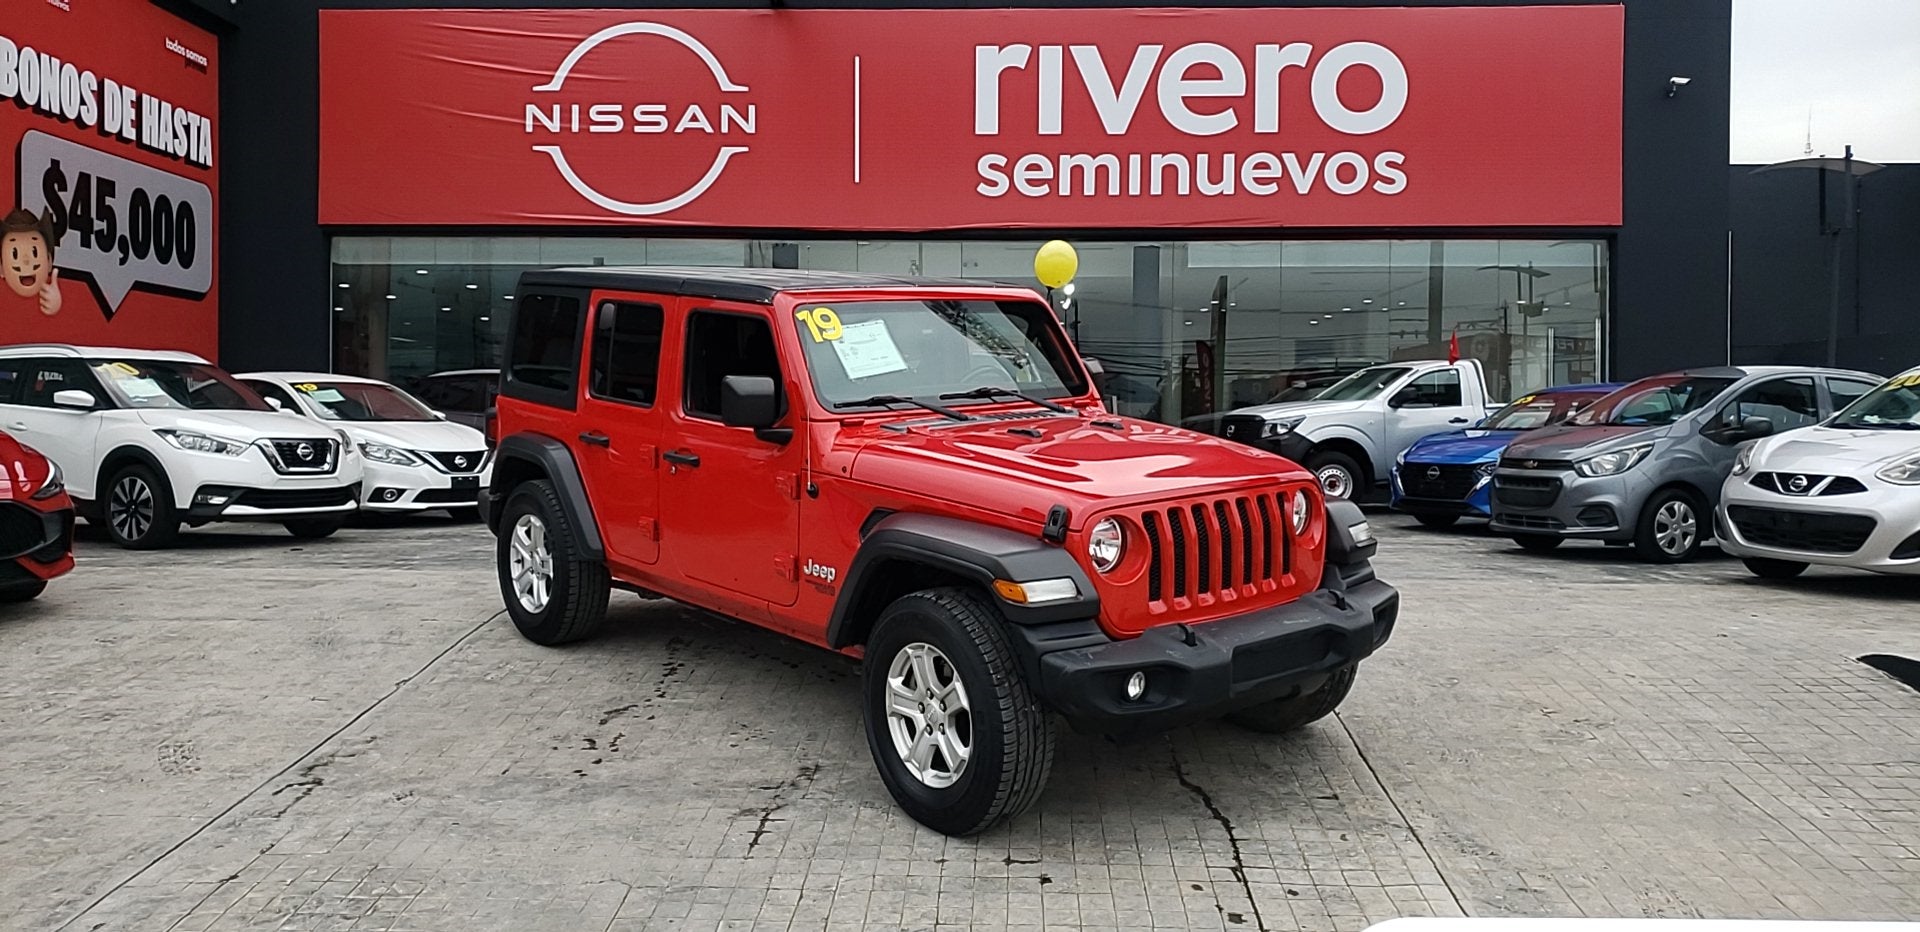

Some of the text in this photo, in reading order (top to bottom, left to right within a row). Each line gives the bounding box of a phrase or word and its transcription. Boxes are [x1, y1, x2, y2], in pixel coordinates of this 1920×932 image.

[165, 37, 208, 66] todos somos
[0, 36, 213, 167] BONOS DE HASTA
[974, 41, 1409, 135] rivero
[525, 104, 756, 133] NISSAN
[975, 150, 1408, 196] seminuevos
[42, 158, 197, 269] $45,000
[795, 307, 843, 343] 19
[294, 383, 318, 392] 19
[803, 558, 836, 583] Jeep
